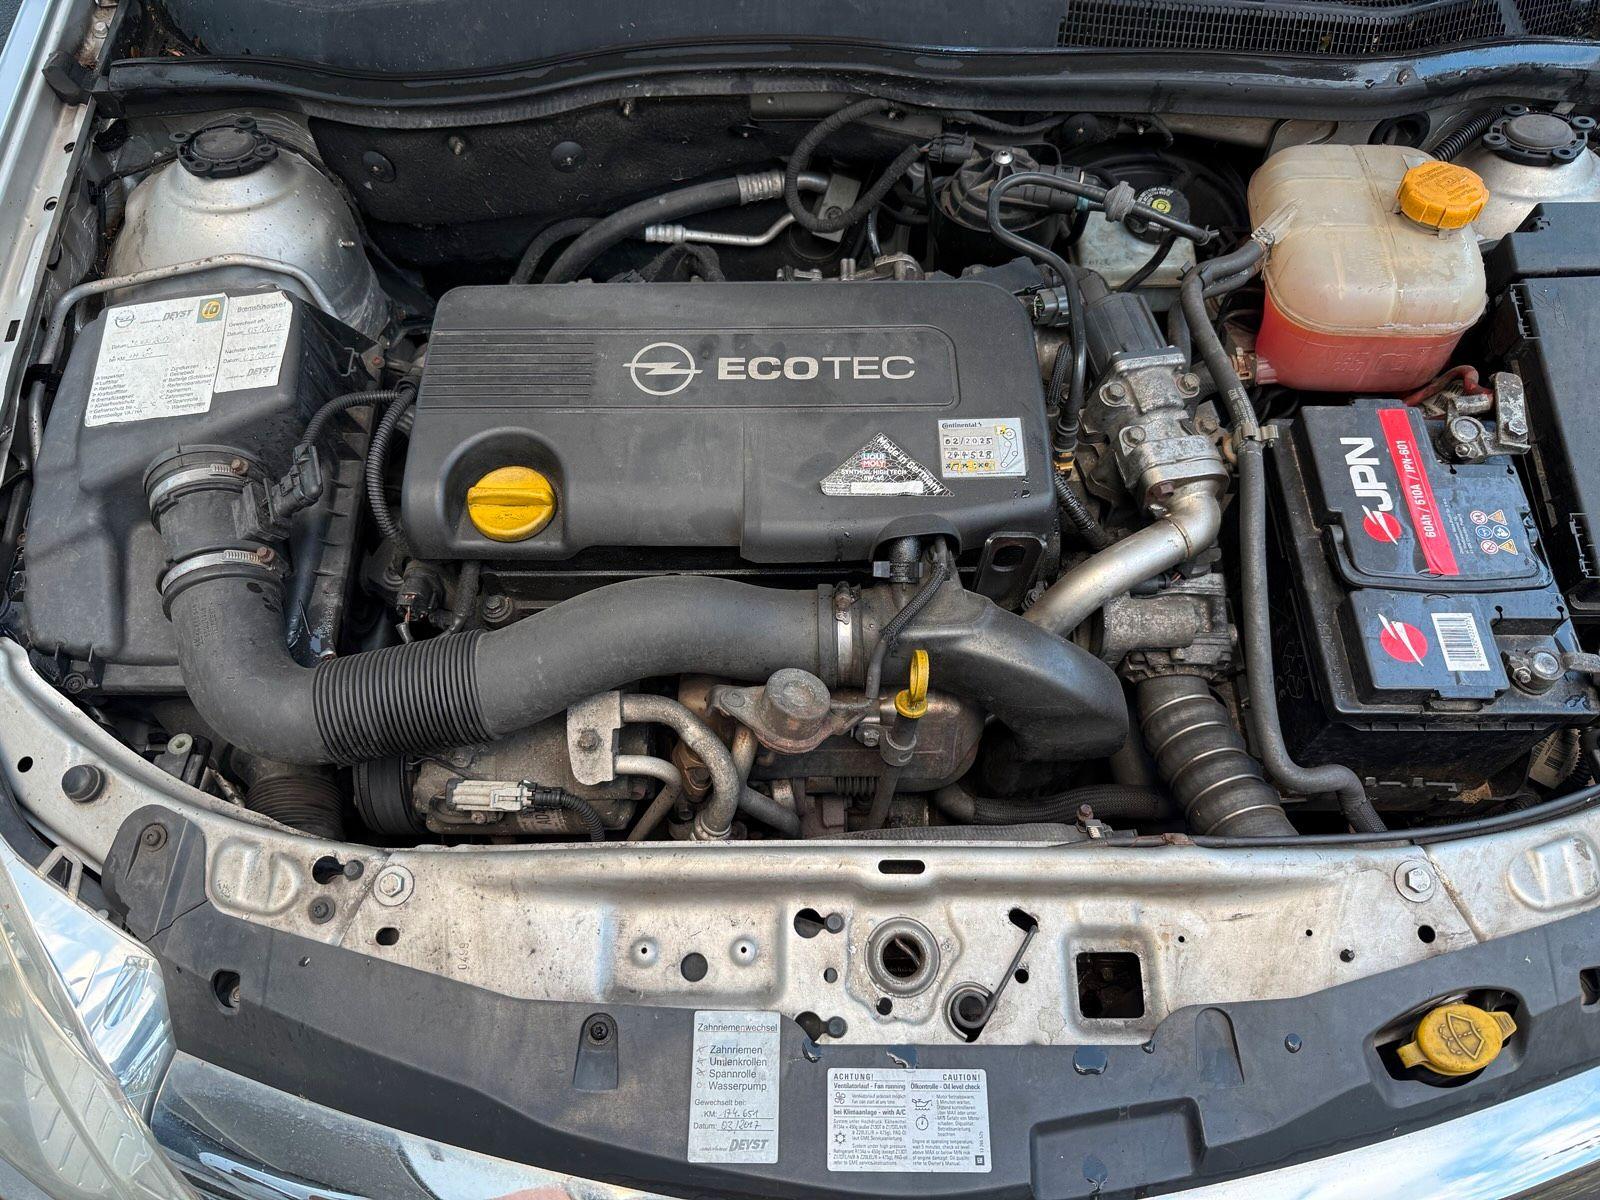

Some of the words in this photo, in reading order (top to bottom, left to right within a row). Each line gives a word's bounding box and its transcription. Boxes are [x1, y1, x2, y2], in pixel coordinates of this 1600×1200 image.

[162, 310, 193, 321] DEYST
[247, 365, 277, 376] DEYST
[718, 356, 916, 380] ECOTEC
[1395, 440, 1416, 474] JPN-601
[877, 436, 902, 457] Made
[906, 461, 943, 494] Germany
[1340, 437, 1393, 512] JPN
[1420, 514, 1436, 538] 60Ah
[697, 1023, 778, 1032] Zahnriemenwechsel
[710, 1044, 763, 1054] Zahnriemen
[709, 1057, 767, 1066] Umlenkrollen
[709, 1069, 757, 1079] Spannrolle
[728, 1139, 769, 1152] DEYST
